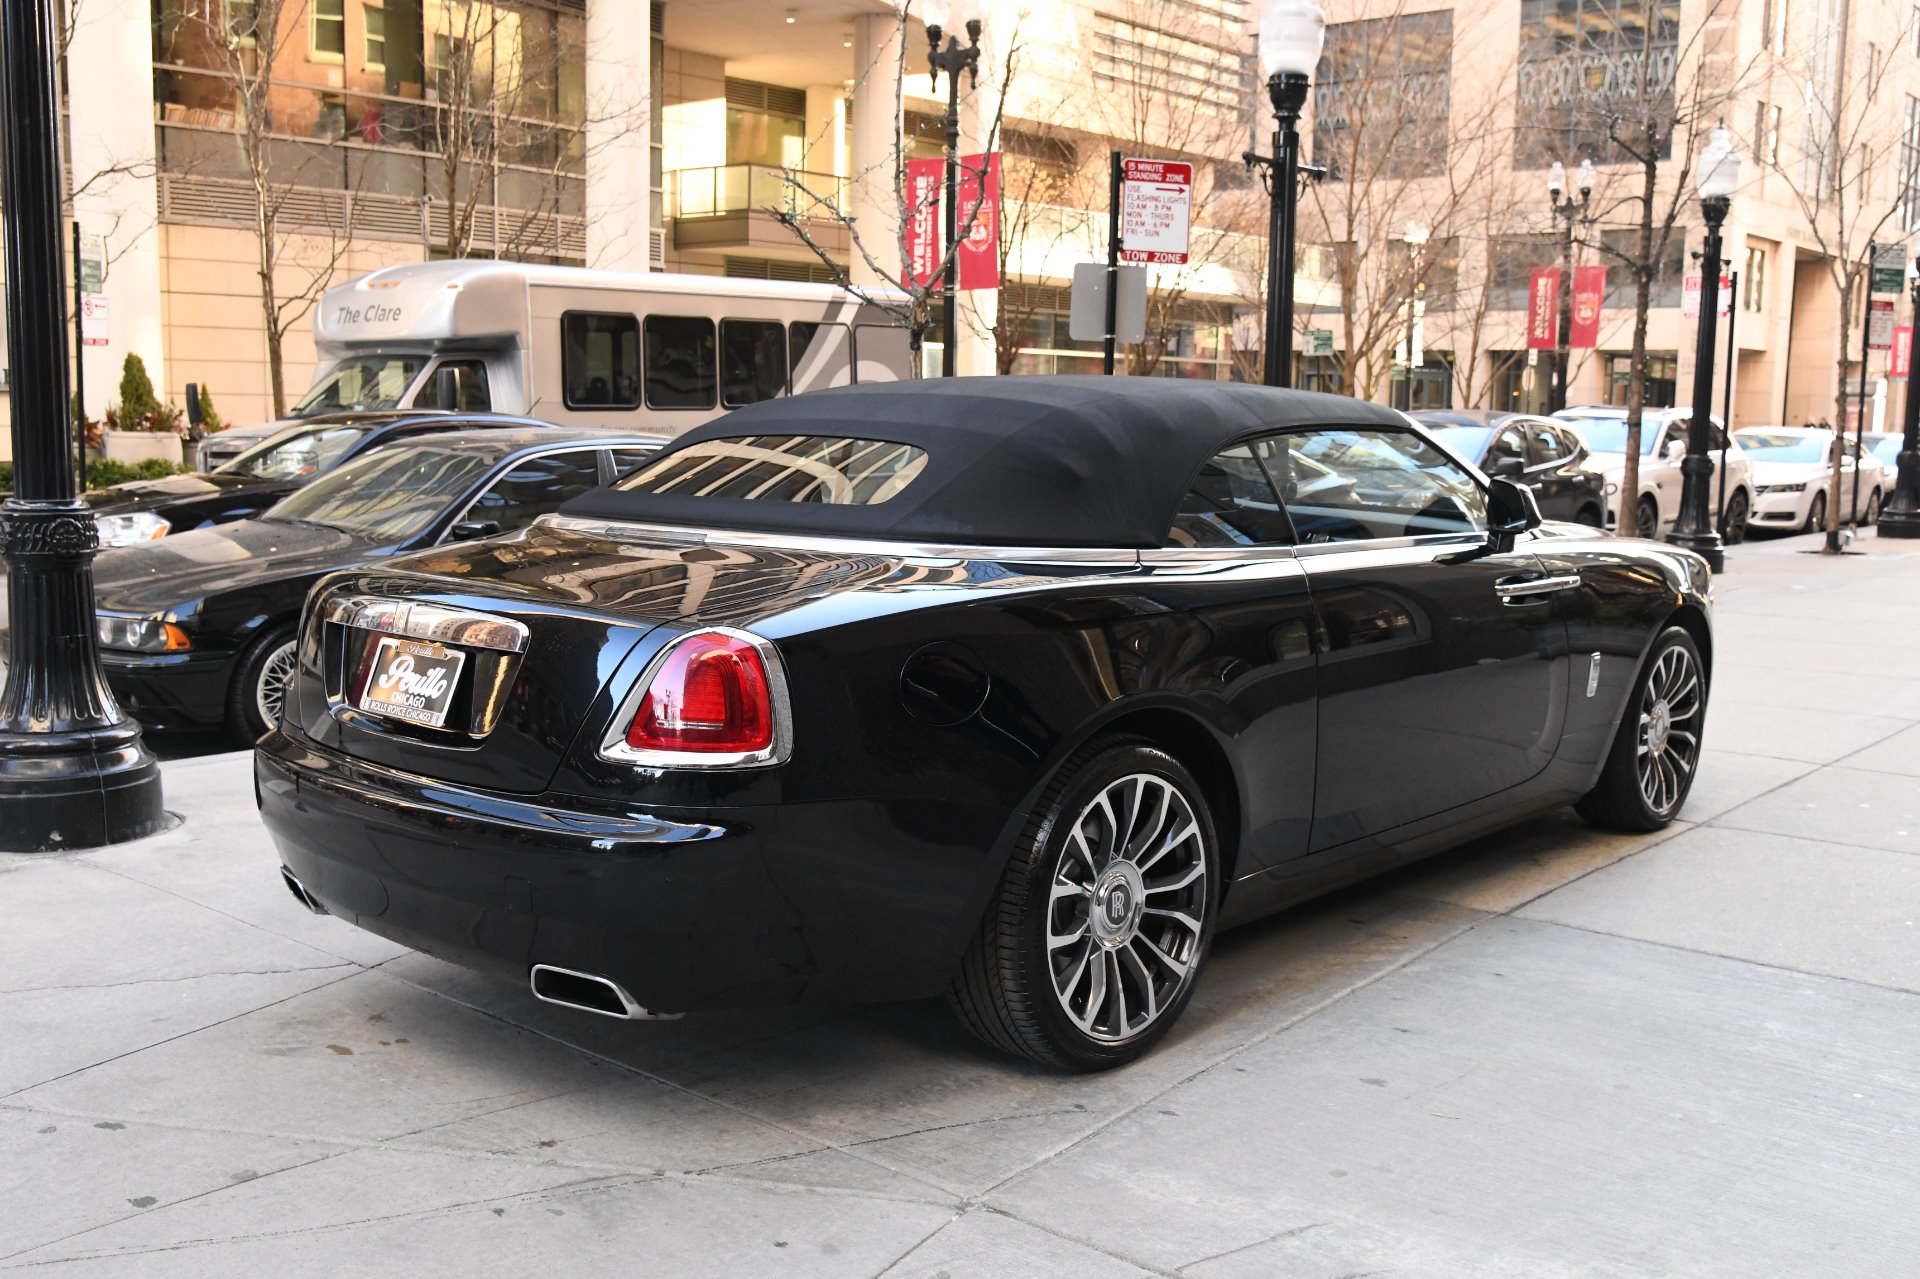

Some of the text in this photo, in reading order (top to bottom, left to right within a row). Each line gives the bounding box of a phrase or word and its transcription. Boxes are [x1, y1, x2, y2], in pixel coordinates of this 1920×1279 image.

[1128, 162, 1164, 173] 15 MINUTE
[1128, 171, 1184, 183] STANDING ZONE
[1127, 194, 1187, 205] FLASHING LIGHTS
[1151, 213, 1175, 221] THURS
[913, 176, 927, 275] WELCOME
[1145, 229, 1160, 237] SUN
[1125, 251, 1183, 263] TOW ZONE
[337, 304, 402, 325] The Clare
[391, 692, 426, 709] CHICAGO
[371, 700, 431, 722] ROLLS ROYCE CHICAGO
